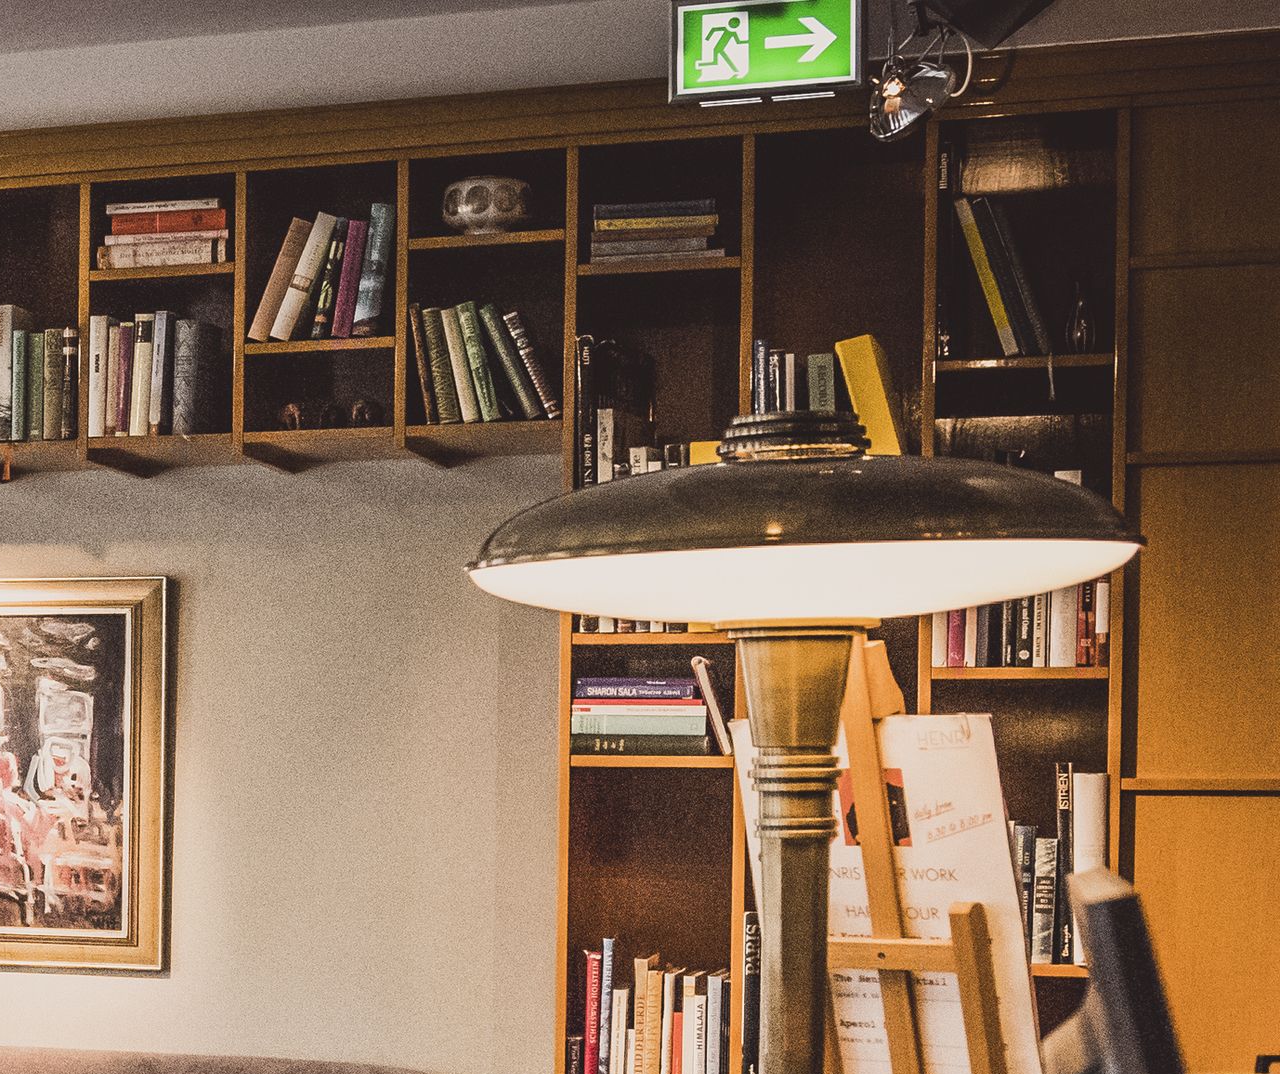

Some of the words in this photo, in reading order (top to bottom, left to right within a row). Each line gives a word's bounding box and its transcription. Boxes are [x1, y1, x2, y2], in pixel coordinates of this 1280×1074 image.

[587, 686, 617, 697] SHARON
[618, 686, 638, 697] SALA
[915, 730, 968, 746] HENR
[1058, 773, 1069, 810] ISTRIEN
[828, 866, 862, 881] NRIS
[910, 867, 958, 882] WORK
[904, 906, 940, 921] OUR
[745, 924, 760, 976] PARIS
[833, 973, 852, 982] The
[636, 994, 645, 1025] ERDE
[839, 1019, 876, 1029] Aperol
[635, 1028, 644, 1051] DER
